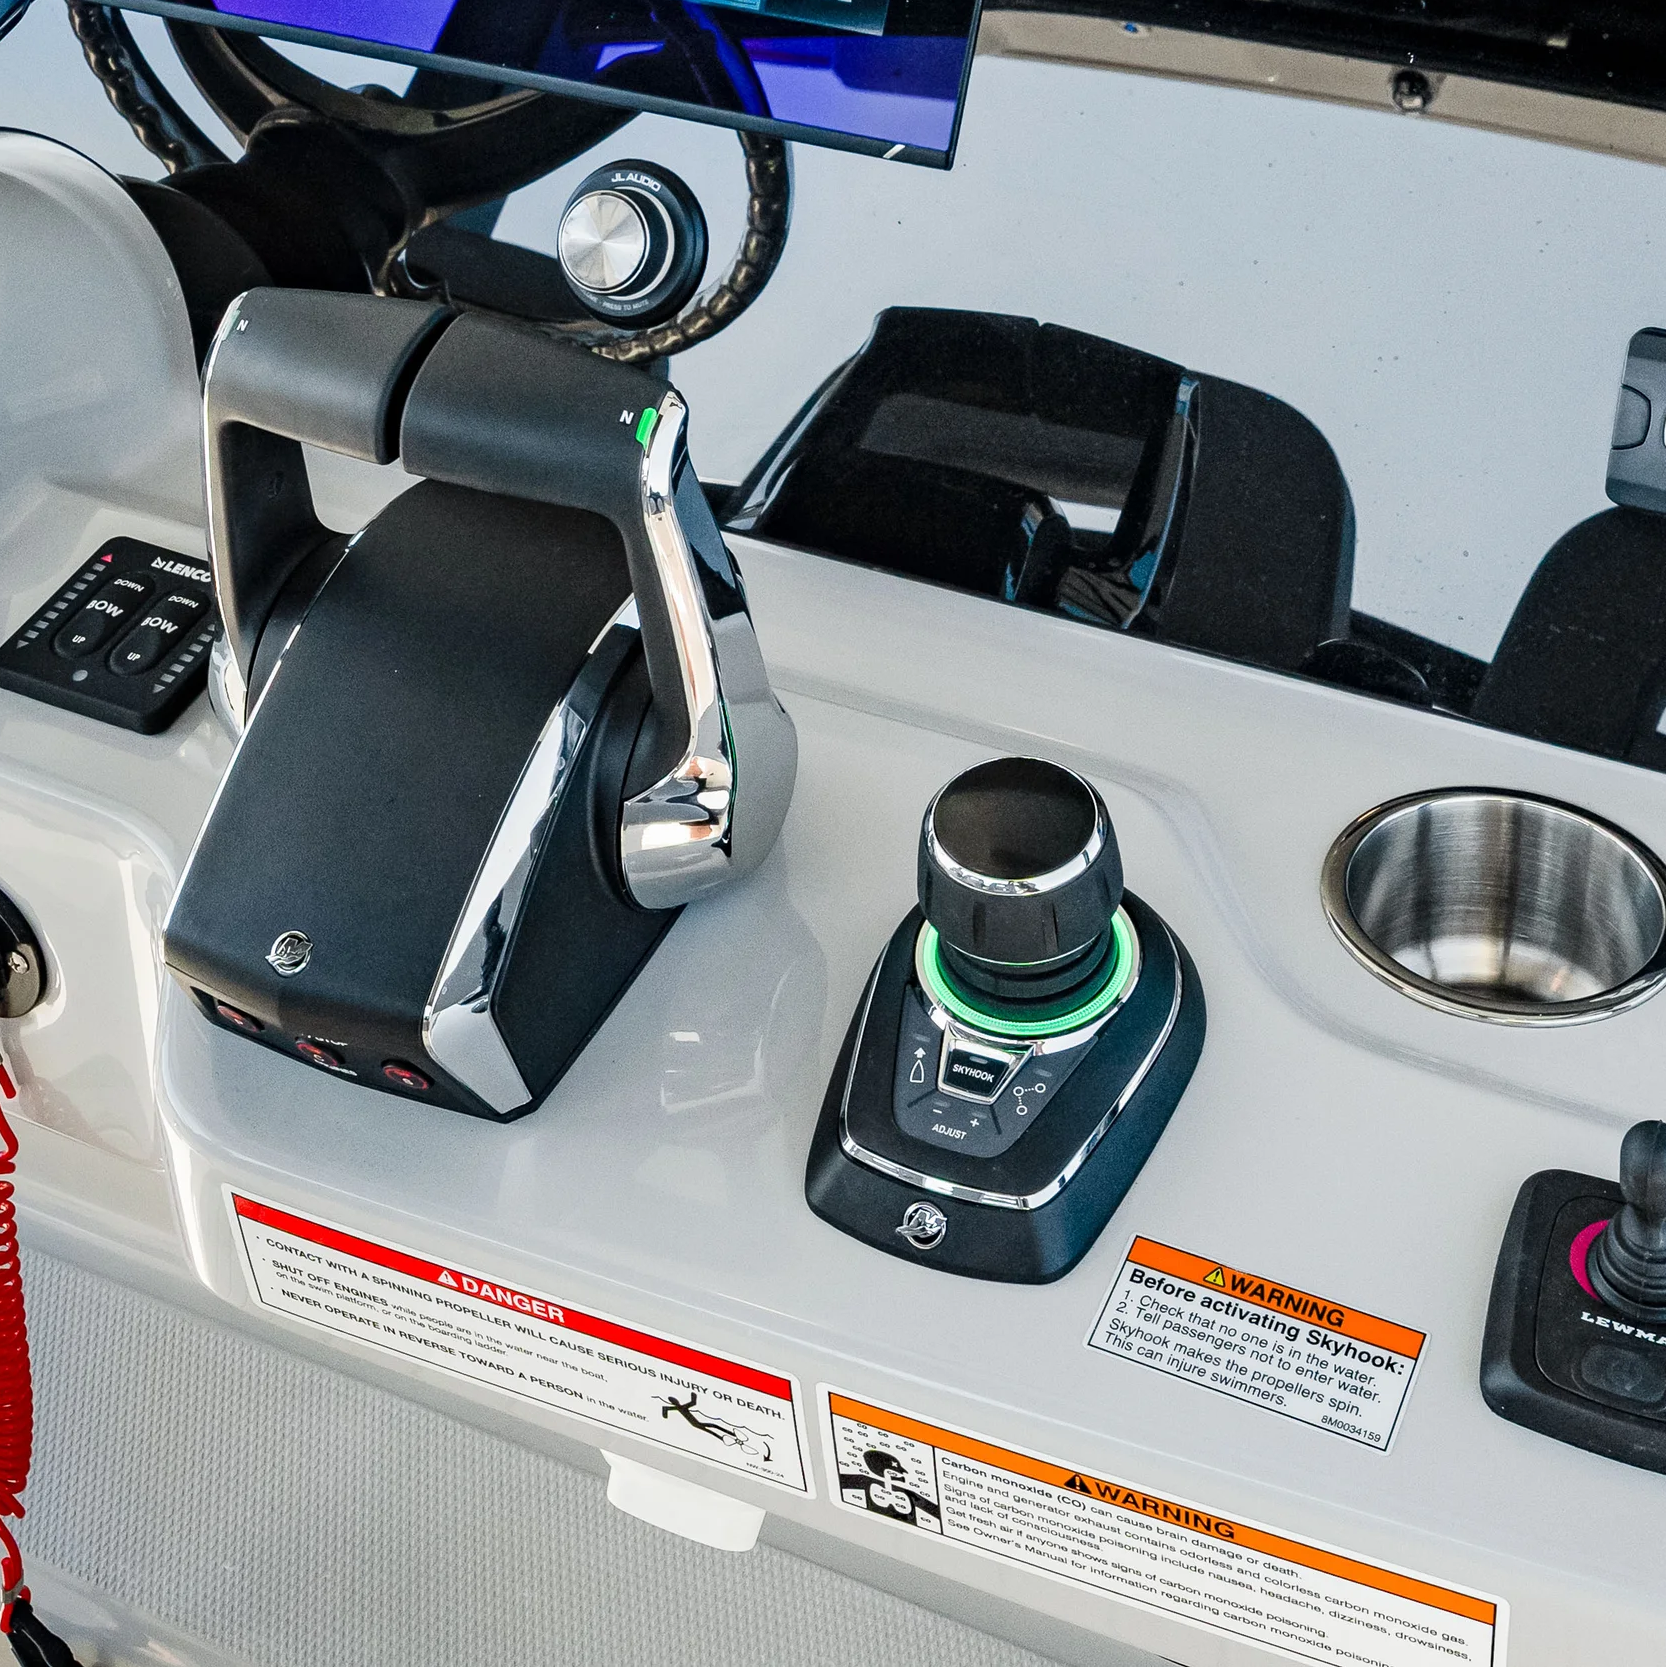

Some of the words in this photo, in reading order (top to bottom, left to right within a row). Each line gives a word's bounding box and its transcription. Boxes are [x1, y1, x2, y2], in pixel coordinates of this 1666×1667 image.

[611, 173, 626, 182] JL
[626, 173, 661, 192] AUDIO
[237, 319, 248, 331] N
[620, 410, 634, 424] N
[162, 560, 211, 582] LENCO
[114, 579, 145, 592] DOWN
[86, 600, 124, 617] BOW
[168, 595, 199, 608] DOWN
[141, 617, 179, 633] BOW
[72, 635, 85, 644] UP
[127, 652, 141, 661] UP
[952, 1063, 995, 1083] SKYHOOK
[932, 1123, 967, 1141] ADJUST
[272, 1259, 304, 1277] SHUT
[307, 1271, 330, 1285] OFF
[334, 1281, 389, 1306] ENGINES
[460, 1275, 565, 1323] DANGER
[1231, 1274, 1345, 1328] WARNING
[266, 1238, 323, 1264] CONTACT
[326, 1259, 357, 1277] WITH
[360, 1271, 369, 1280] A
[372, 1275, 432, 1302] SPINNING
[436, 1297, 511, 1329] PROPELLER
[514, 1324, 547, 1341] WILL
[549, 1336, 594, 1357] CAUSE
[597, 1352, 657, 1378] SERIOUS
[660, 1372, 708, 1395] INJURY
[712, 1389, 733, 1403] OR
[736, 1397, 786, 1420] DEATH.
[1129, 1268, 1196, 1302] Before
[1200, 1293, 1301, 1341] activating
[1306, 1328, 1405, 1376] Skyhook:
[281, 1289, 322, 1309] NEVER
[324, 1304, 380, 1329] OPERATE
[383, 1324, 396, 1335] IN
[399, 1329, 456, 1356] REVERSE
[458, 1350, 515, 1376] TOWARD
[518, 1372, 528, 1381] A
[529, 1375, 584, 1400] PERSON
[1116, 1301, 1129, 1315] 2.
[1135, 1307, 1160, 1324] Tell
[1162, 1319, 1246, 1356] passengers
[1250, 1349, 1273, 1366] not
[1277, 1357, 1291, 1372] to
[1295, 1364, 1334, 1386] enter
[1338, 1376, 1381, 1403] water.
[1123, 1290, 1134, 1302] 1.
[1139, 1294, 1185, 1319] Check
[1188, 1308, 1215, 1329] that
[1218, 1322, 1237, 1337] no
[1241, 1330, 1268, 1347] one
[1272, 1337, 1285, 1353] is
[1288, 1341, 1301, 1358] in
[1306, 1348, 1329, 1369] the
[1333, 1361, 1377, 1387] water.
[1104, 1331, 1133, 1351] This
[1136, 1344, 1164, 1361] can
[1167, 1352, 1207, 1379] injure
[1210, 1369, 1288, 1407] swimmers.
[1109, 1317, 1171, 1348] Skyhook
[1173, 1340, 1221, 1367] makes
[1225, 1356, 1248, 1376] the
[1251, 1367, 1325, 1403] propellers
[1328, 1391, 1363, 1418] spin.
[1321, 1415, 1381, 1443] 8M0034159
[941, 1457, 988, 1478] Carbon
[991, 1472, 1053, 1499] monoxide
[1057, 1494, 1087, 1511] (CO)
[1090, 1506, 1113, 1520] can
[1116, 1515, 1153, 1531] cause
[1156, 1525, 1188, 1542] brain
[1192, 1538, 1242, 1560] damage
[1246, 1555, 1259, 1565] or
[1263, 1561, 1302, 1579] death.
[1094, 1482, 1235, 1539] WARNING
